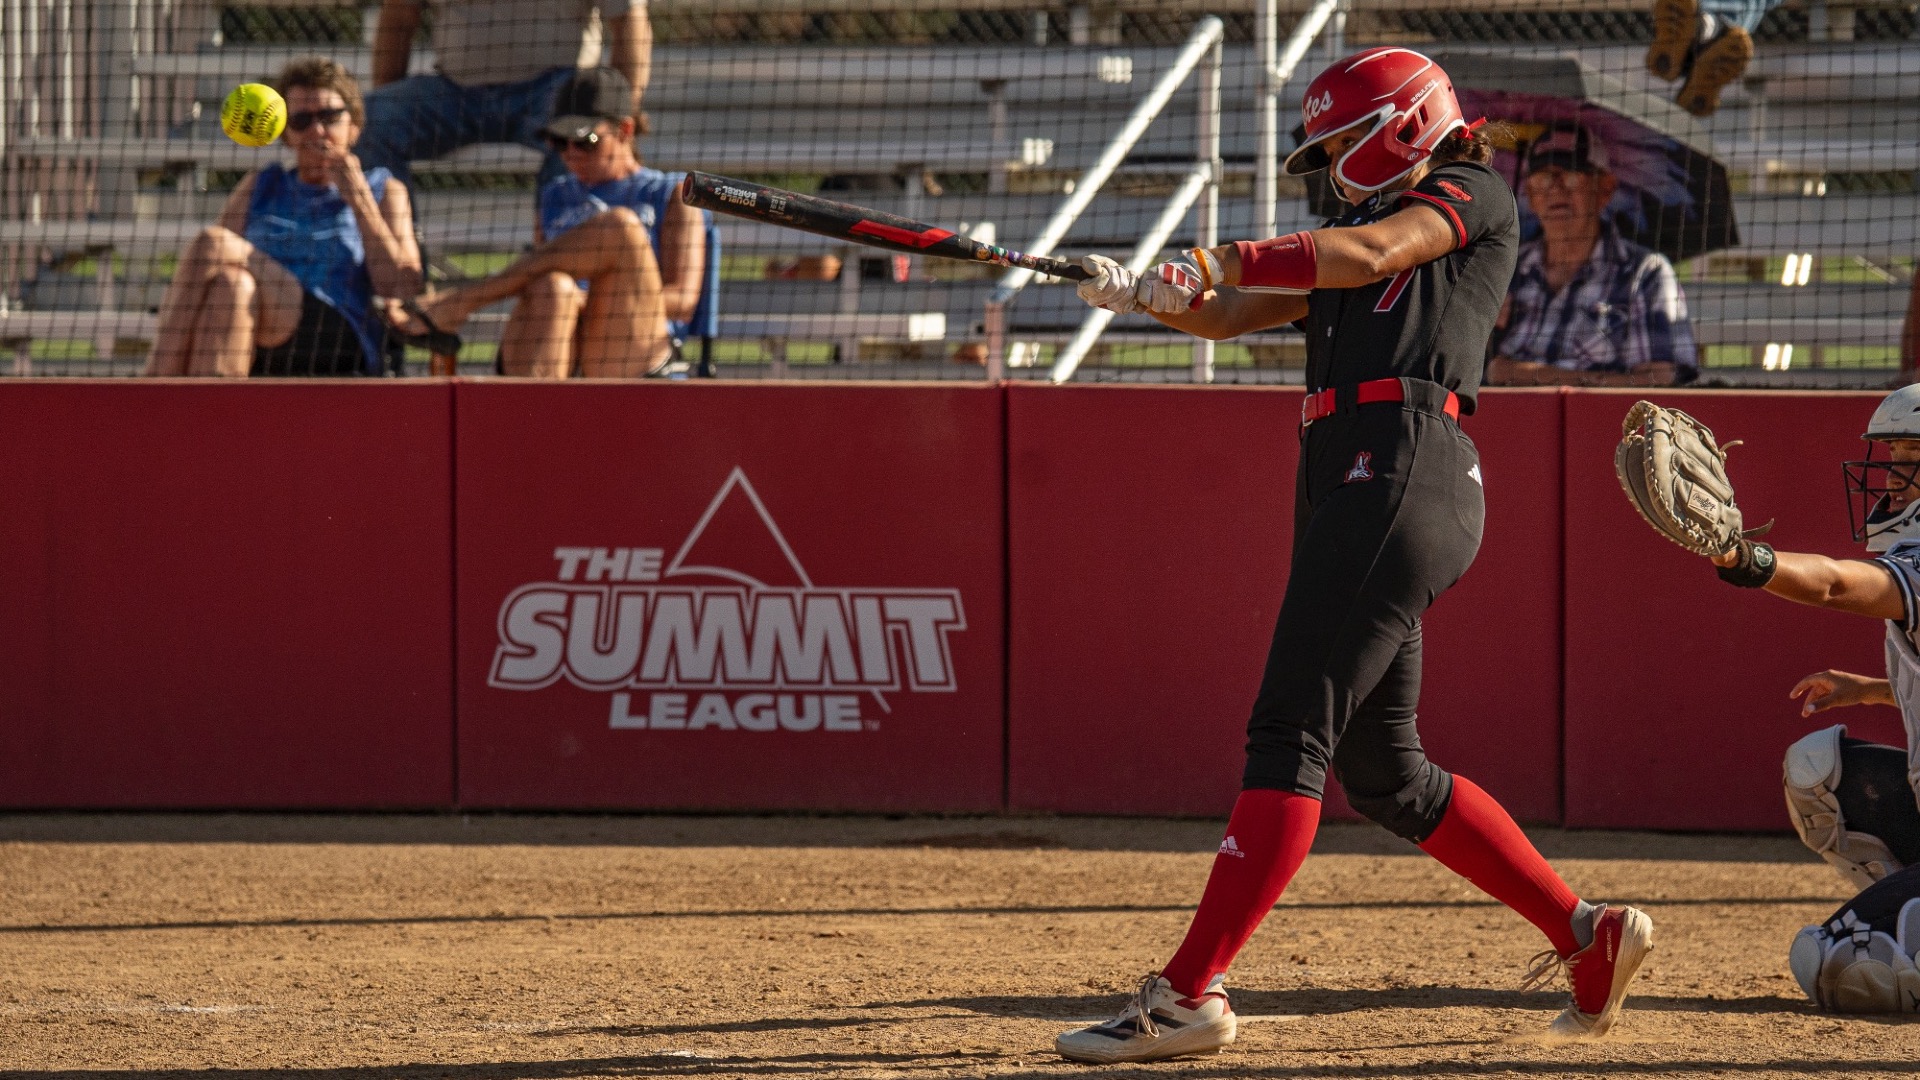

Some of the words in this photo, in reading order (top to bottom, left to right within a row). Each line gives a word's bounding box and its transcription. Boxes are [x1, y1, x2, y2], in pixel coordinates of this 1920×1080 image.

[720, 195, 756, 207] DOUBLE
[722, 186, 757, 199] BARREL
[554, 547, 664, 581] THE
[488, 583, 967, 691] SUMMIT
[609, 693, 862, 731] LEAGUE
